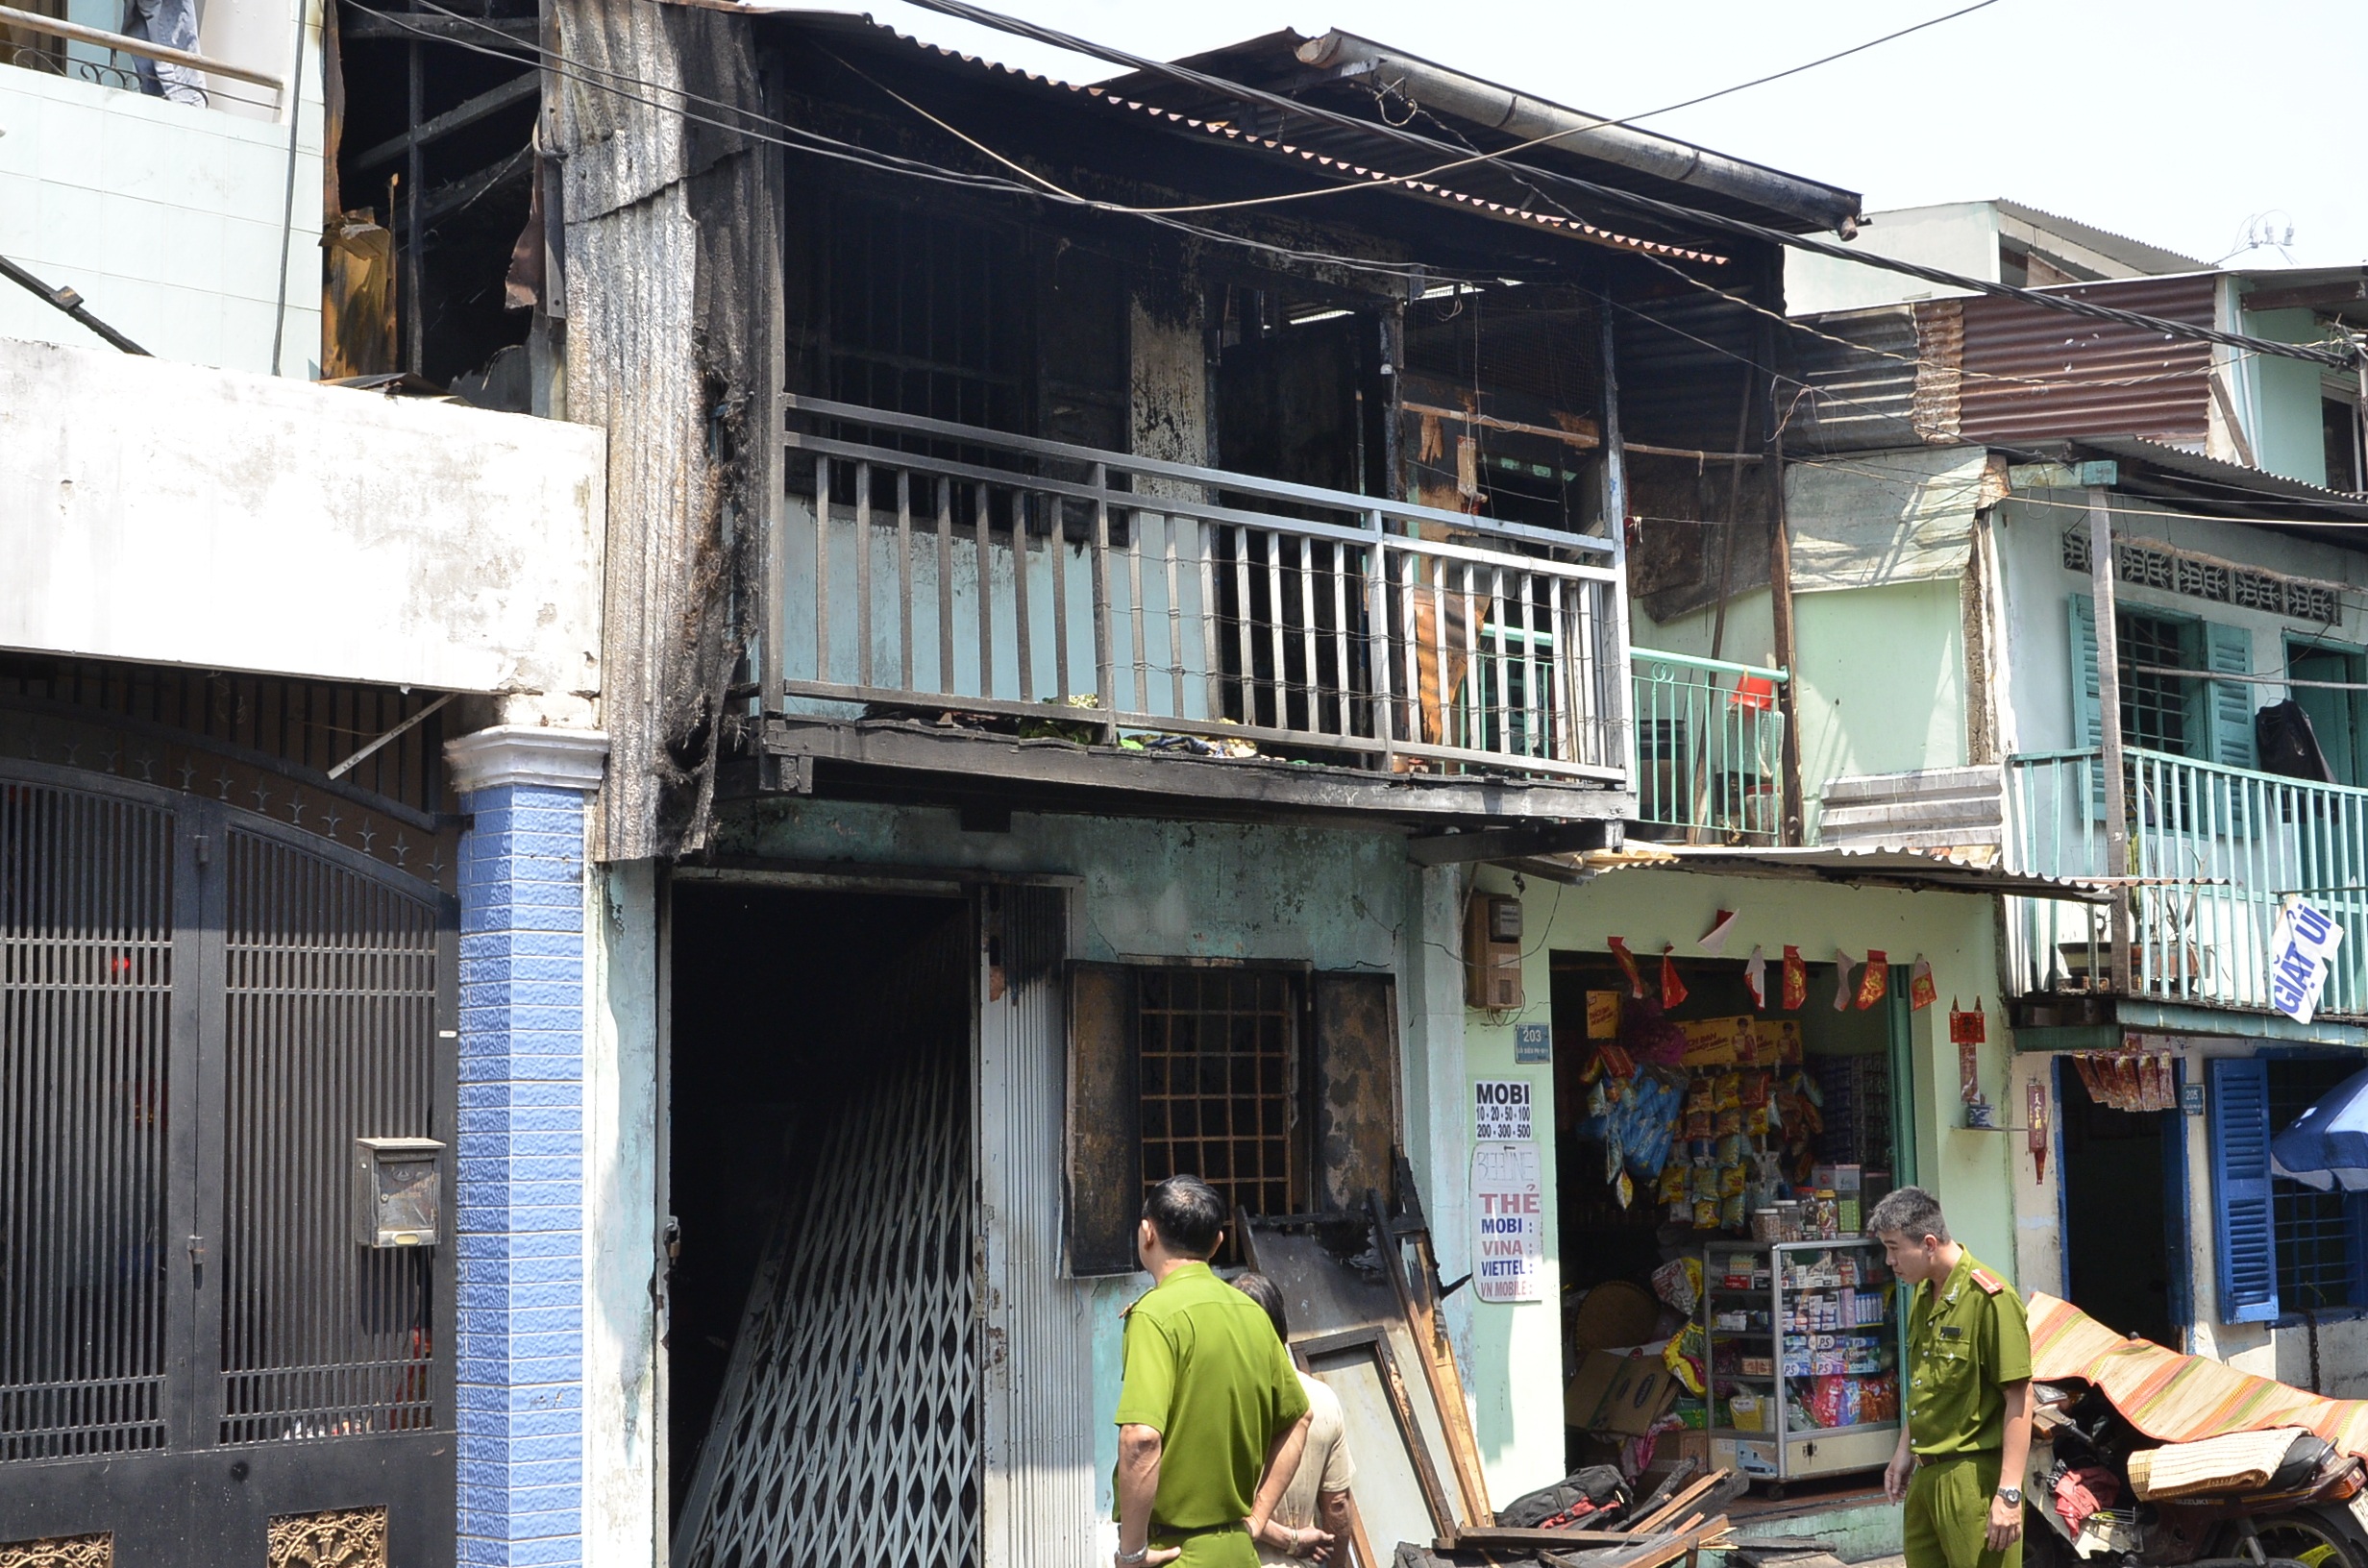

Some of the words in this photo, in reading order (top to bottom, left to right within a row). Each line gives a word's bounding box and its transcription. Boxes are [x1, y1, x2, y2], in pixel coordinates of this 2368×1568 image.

[2286, 903, 2331, 945] ỦI
[1522, 1029, 1542, 1042] 203
[1476, 1083, 1530, 1105] MOBI
[2185, 1089, 2199, 1101] 205
[1478, 1183, 1541, 1213] THẺ
[1481, 1282, 1492, 1297] VN
[1818, 1336, 1831, 1349] PS
[1784, 1364, 1796, 1375] PS
[1817, 1363, 1830, 1373] PS
